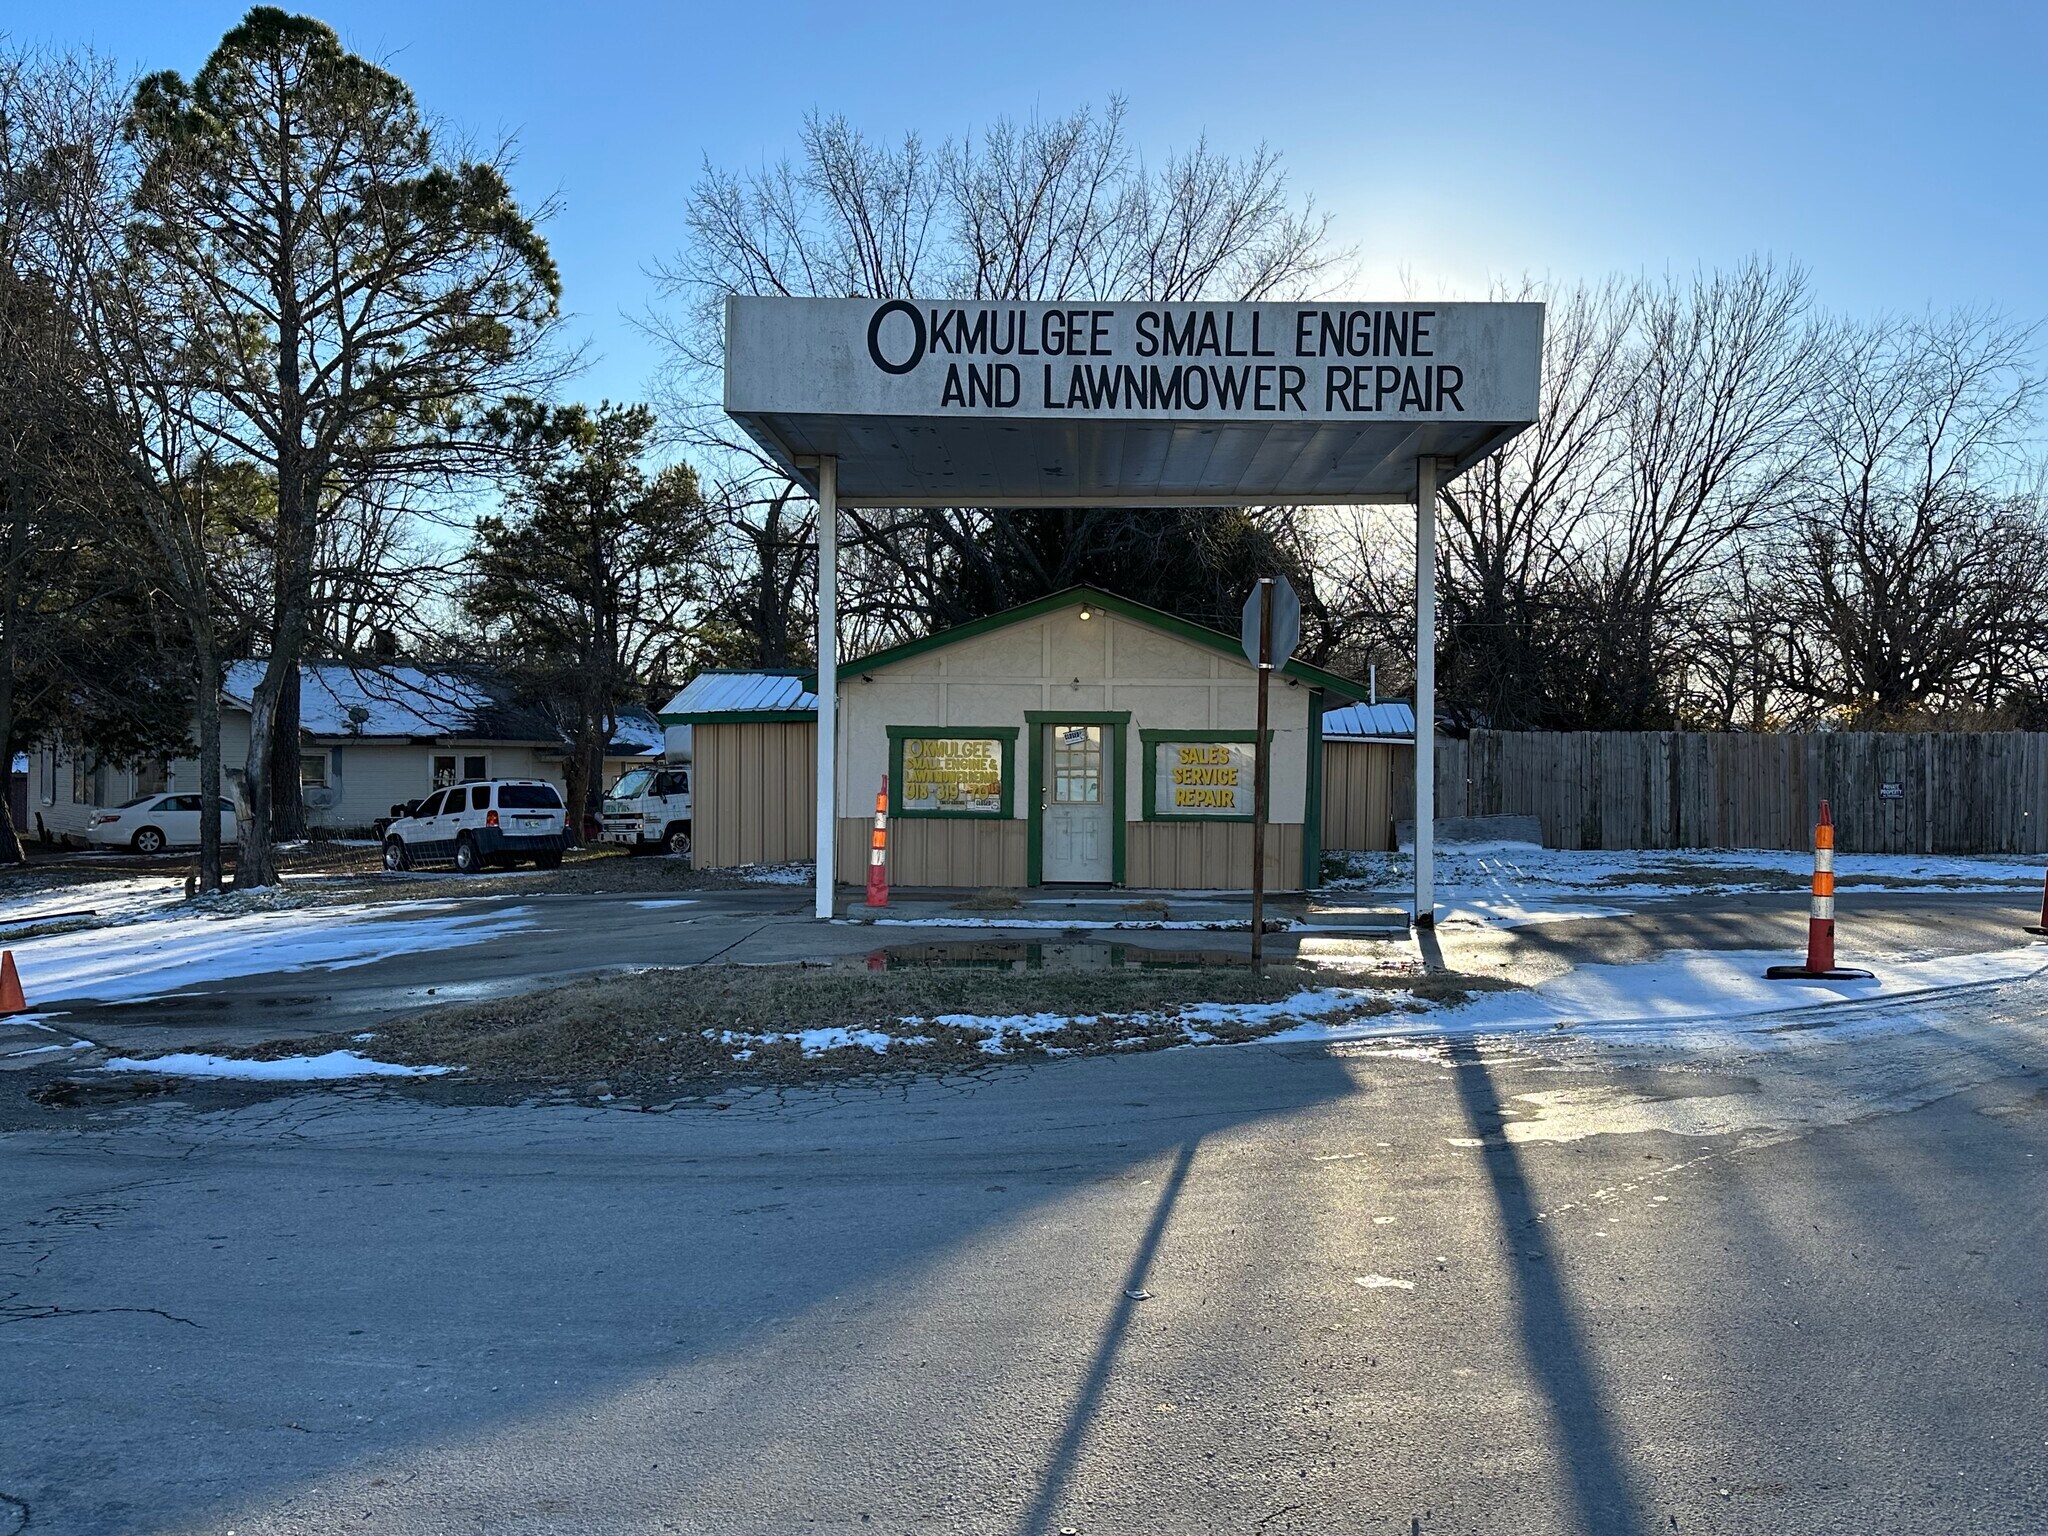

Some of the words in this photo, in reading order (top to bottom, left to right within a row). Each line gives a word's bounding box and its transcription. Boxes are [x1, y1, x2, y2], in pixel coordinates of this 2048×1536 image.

[867, 300, 1114, 374] OKMULGEE
[1136, 311, 1275, 357] SMALL
[1295, 310, 1435, 357] ENGINE
[941, 363, 1021, 408] AND
[1044, 364, 1307, 412] LAWNMOWER
[1325, 365, 1464, 412] REPAIR
[911, 740, 992, 758] OKMULGEE
[1178, 747, 1230, 765] SALES
[905, 759, 943, 770] SMALL
[944, 759, 987, 770] ENGINE
[989, 759, 998, 770] &
[1172, 767, 1238, 786] SERVICE
[1175, 788, 1235, 808] REPAIR
